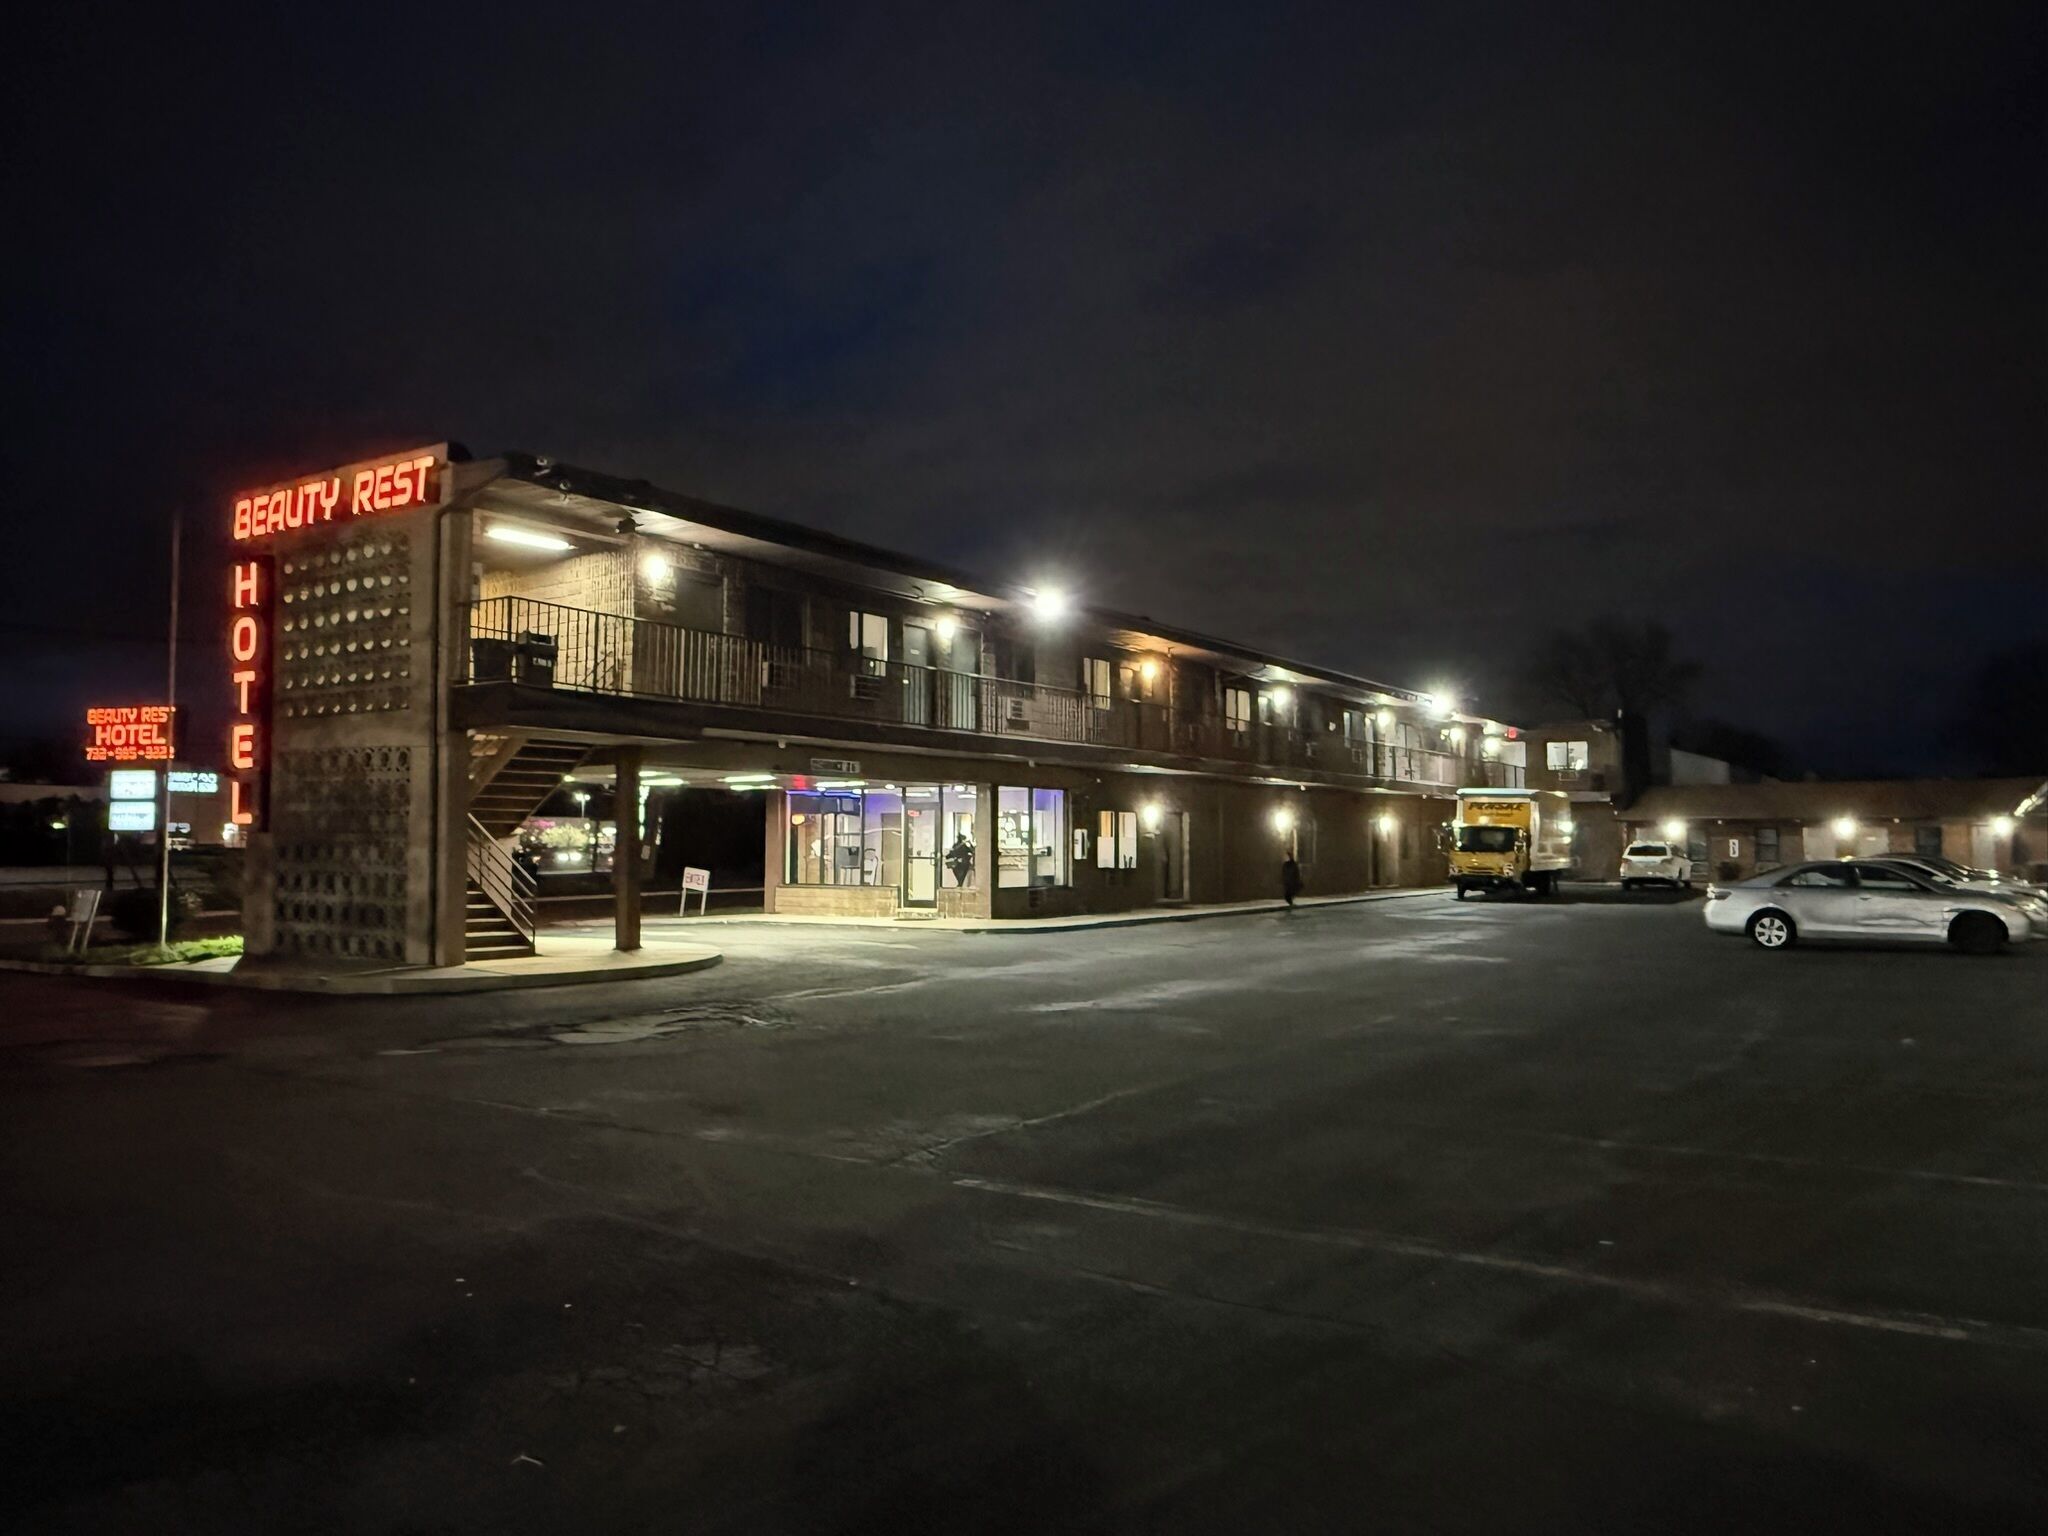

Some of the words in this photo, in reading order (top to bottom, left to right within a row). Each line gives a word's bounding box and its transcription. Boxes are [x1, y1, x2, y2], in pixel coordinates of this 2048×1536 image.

[233, 477, 340, 540] BEAUTY
[352, 456, 434, 515] REST
[87, 707, 138, 725] BEAUTY
[231, 562, 258, 824] HOTEL
[96, 724, 166, 745] HOTEL
